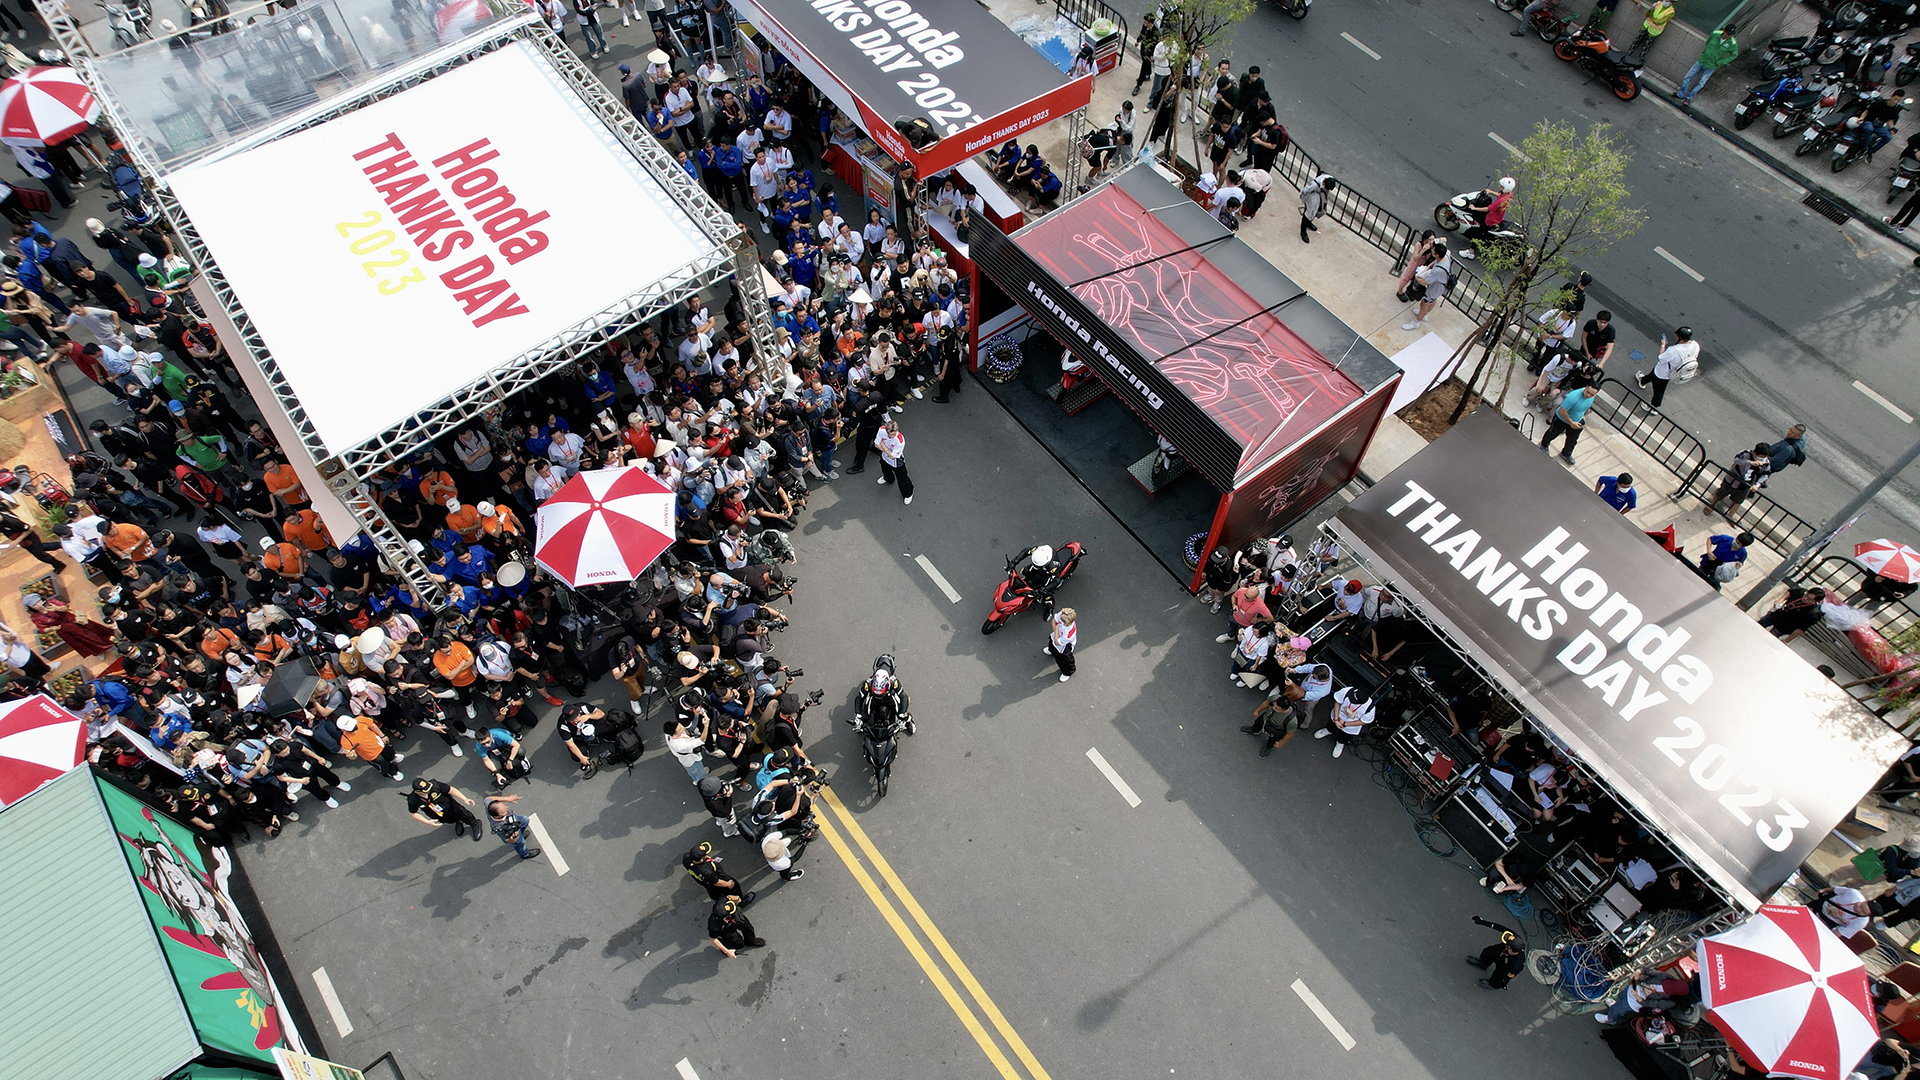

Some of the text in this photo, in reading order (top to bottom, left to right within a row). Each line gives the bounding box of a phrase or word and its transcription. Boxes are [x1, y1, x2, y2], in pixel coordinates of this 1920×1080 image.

[849, 28, 923, 73] DAY
[863, 0, 964, 69] onda
[885, 130, 905, 154] Honda
[965, 109, 1049, 152] Honda THANKS DAY 2023
[352, 131, 530, 329] THANKS DAY
[431, 137, 551, 266] Honda
[334, 210, 426, 296] 2023
[1027, 280, 1164, 410] Honda Racing
[586, 570, 617, 579] HONDA
[1520, 525, 1714, 705] Honda
[1385, 479, 1810, 852] THANKS DAY 2023
[1762, 906, 1800, 915] HONDA
[1715, 953, 1726, 991] HONDA
[1789, 1059, 1826, 1073] HONDA
